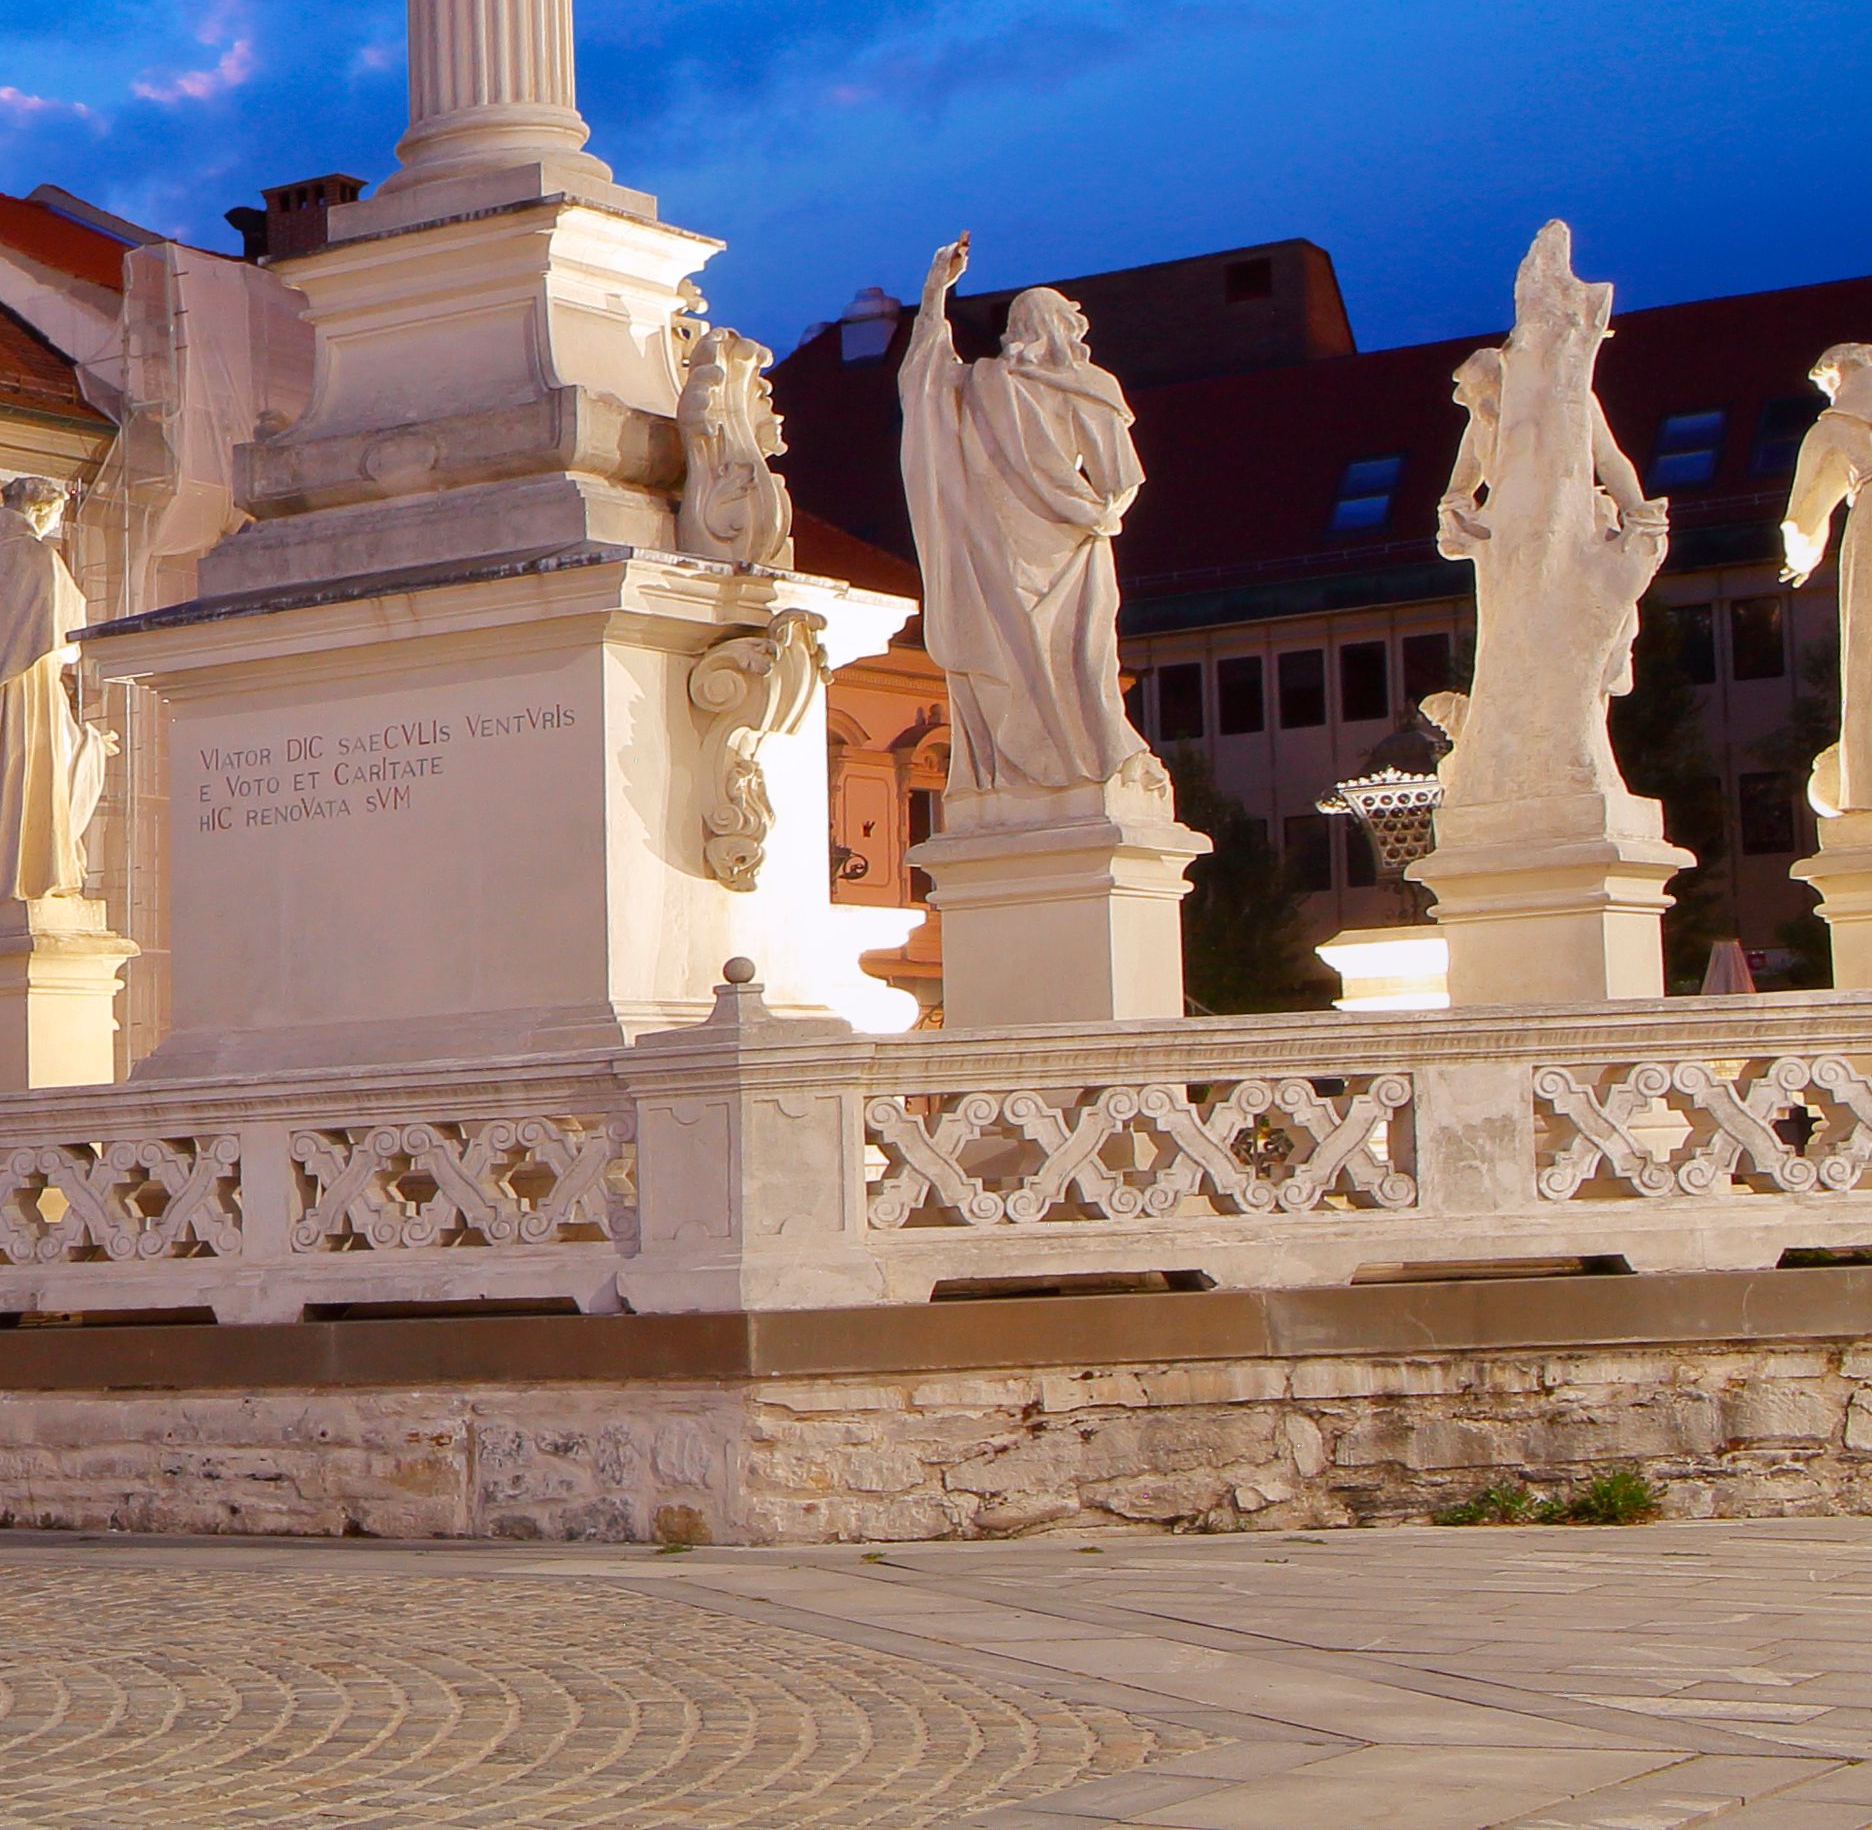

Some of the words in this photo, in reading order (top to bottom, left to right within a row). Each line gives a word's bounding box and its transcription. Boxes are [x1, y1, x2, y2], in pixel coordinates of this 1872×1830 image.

[200, 747, 272, 771] VIATOR
[286, 735, 324, 763] DIC
[338, 719, 451, 756] SAECVLIS
[465, 703, 576, 738] VENTVRIS
[199, 784, 212, 803] E
[226, 774, 280, 798] VOTO
[293, 771, 320, 792] ET
[333, 756, 444, 786] CARITATE
[199, 805, 233, 833] HIC
[246, 796, 352, 827] RENOVATA
[365, 784, 411, 813] SVM
